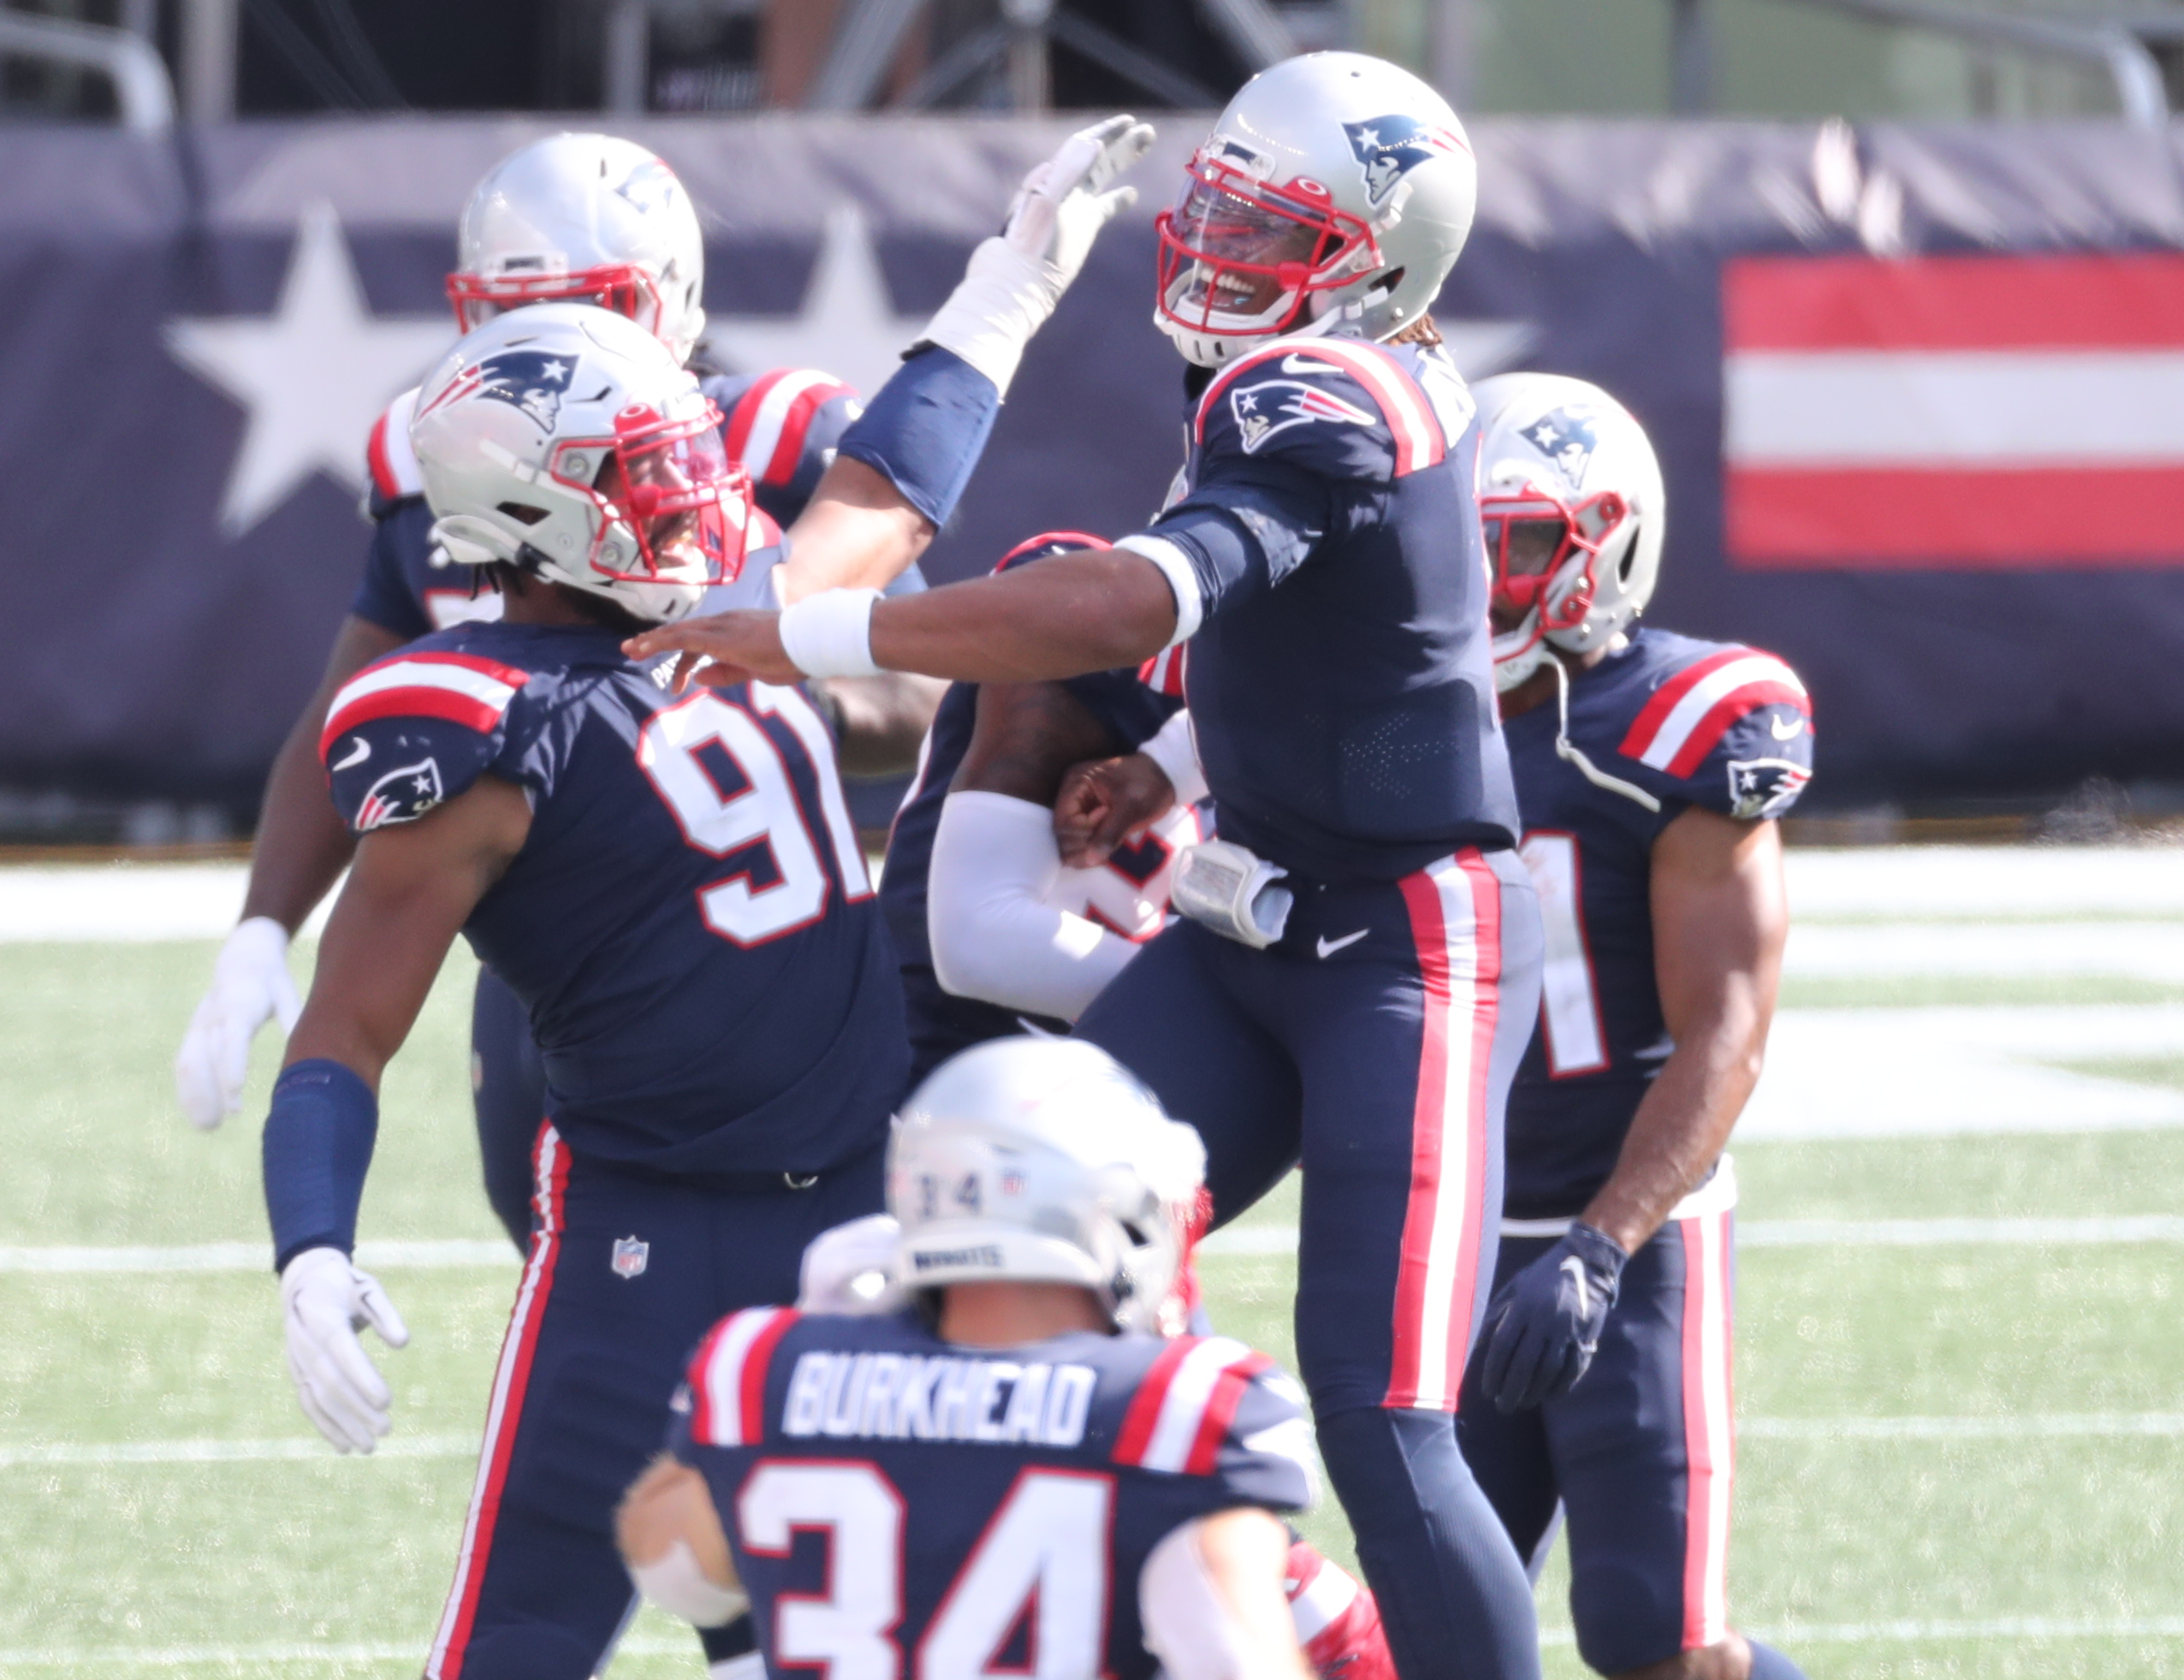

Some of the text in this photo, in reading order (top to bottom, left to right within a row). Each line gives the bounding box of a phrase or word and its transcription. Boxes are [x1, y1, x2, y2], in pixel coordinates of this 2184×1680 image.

[636, 679, 877, 950] 91
[782, 1351, 1096, 1447] BURKHEAD
[735, 1453, 1119, 1680] 34
